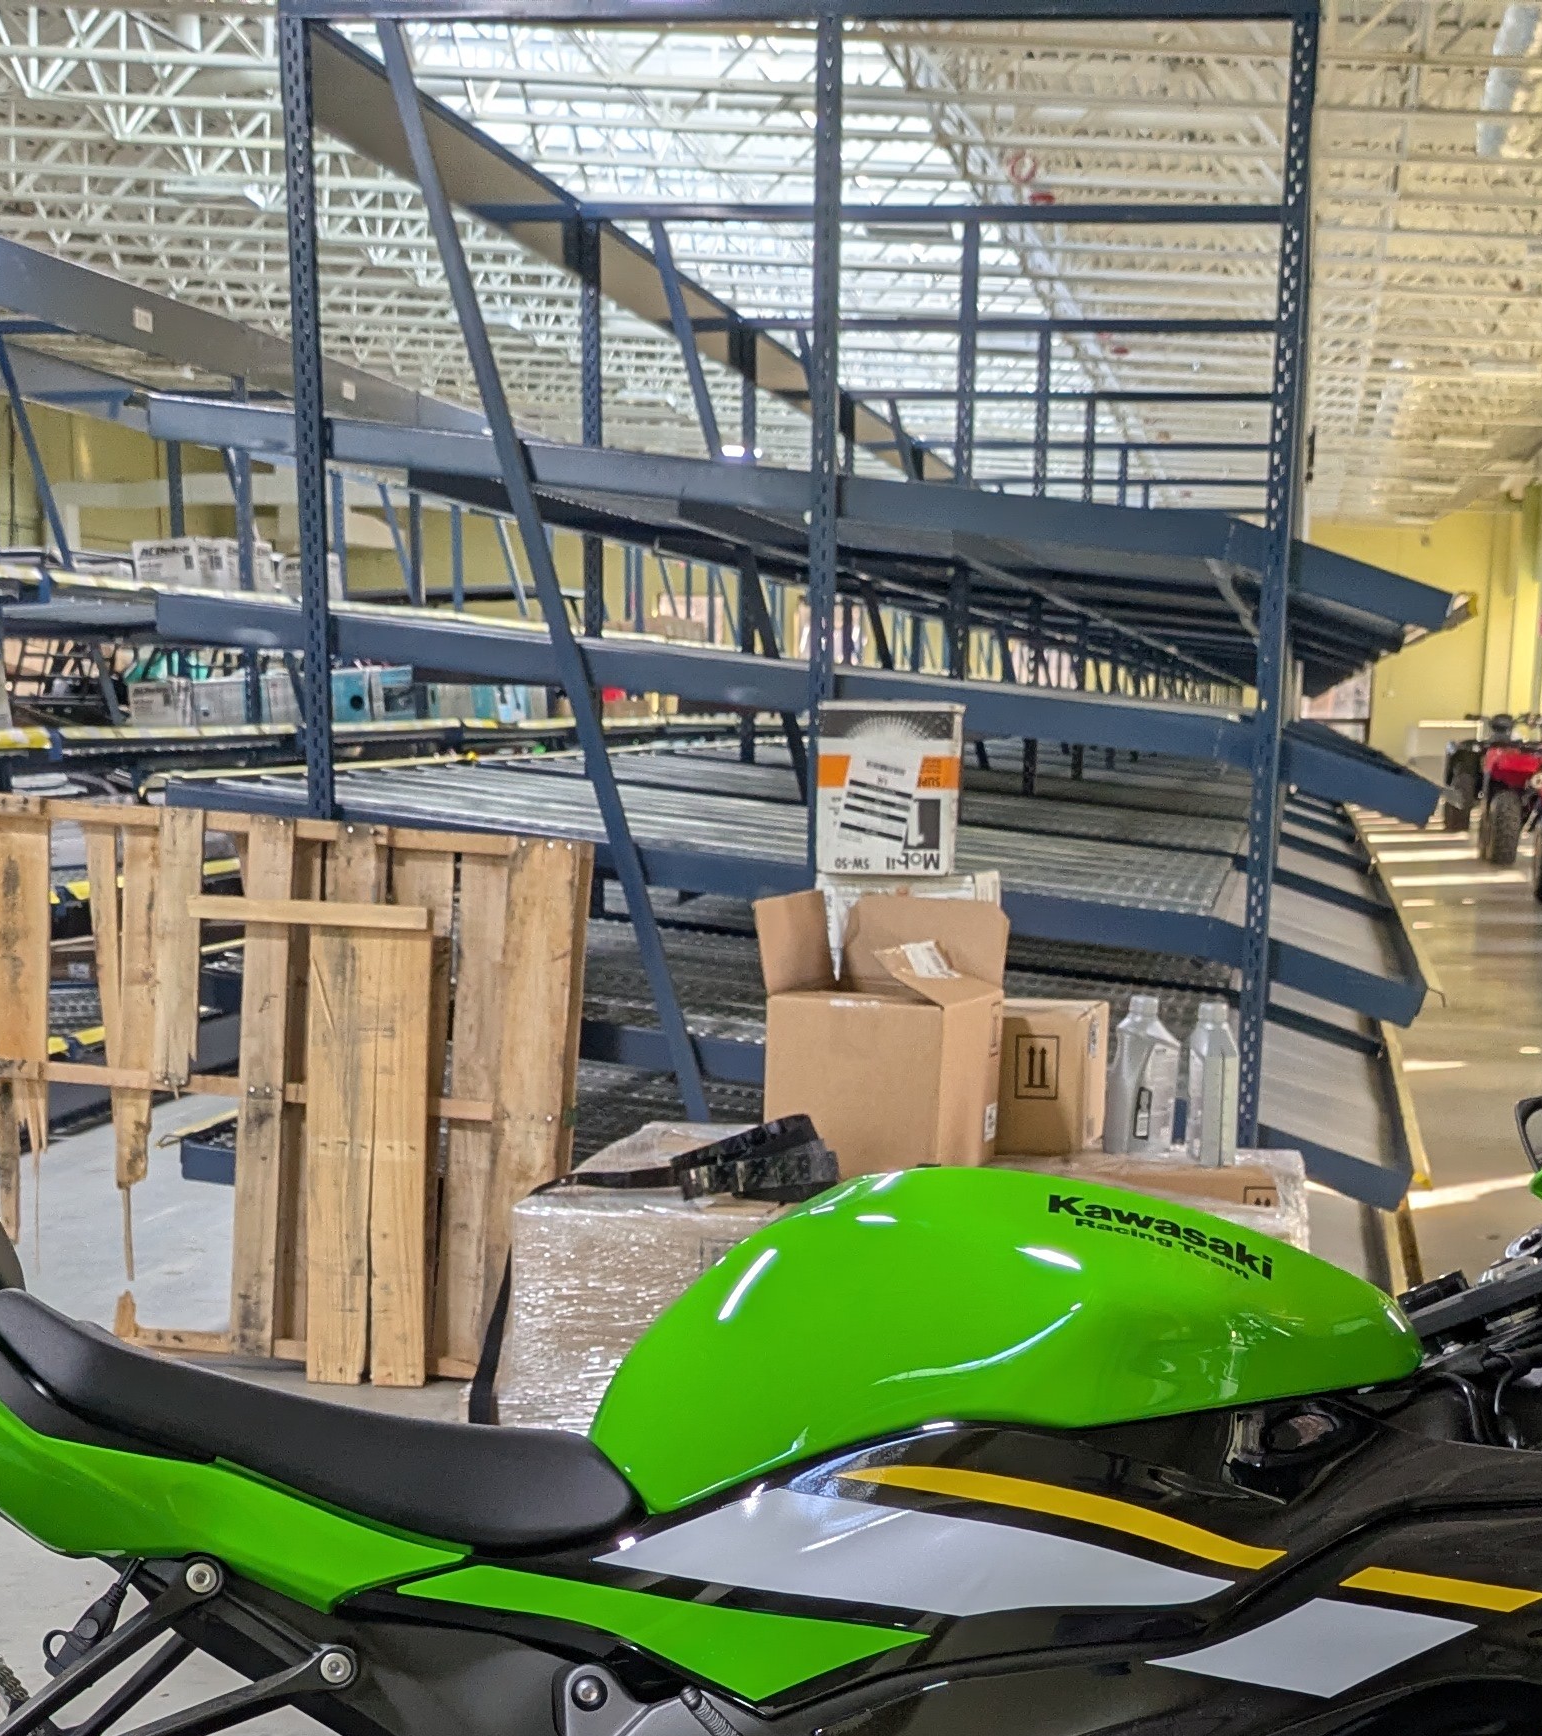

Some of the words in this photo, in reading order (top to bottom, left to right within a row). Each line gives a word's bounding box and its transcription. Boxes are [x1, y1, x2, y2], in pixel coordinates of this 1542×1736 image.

[886, 852, 940, 870] Mobil
[1047, 1194, 1273, 1281] Kawasaki
[1075, 1218, 1173, 1248] Racing
[1178, 1241, 1250, 1280] Team
